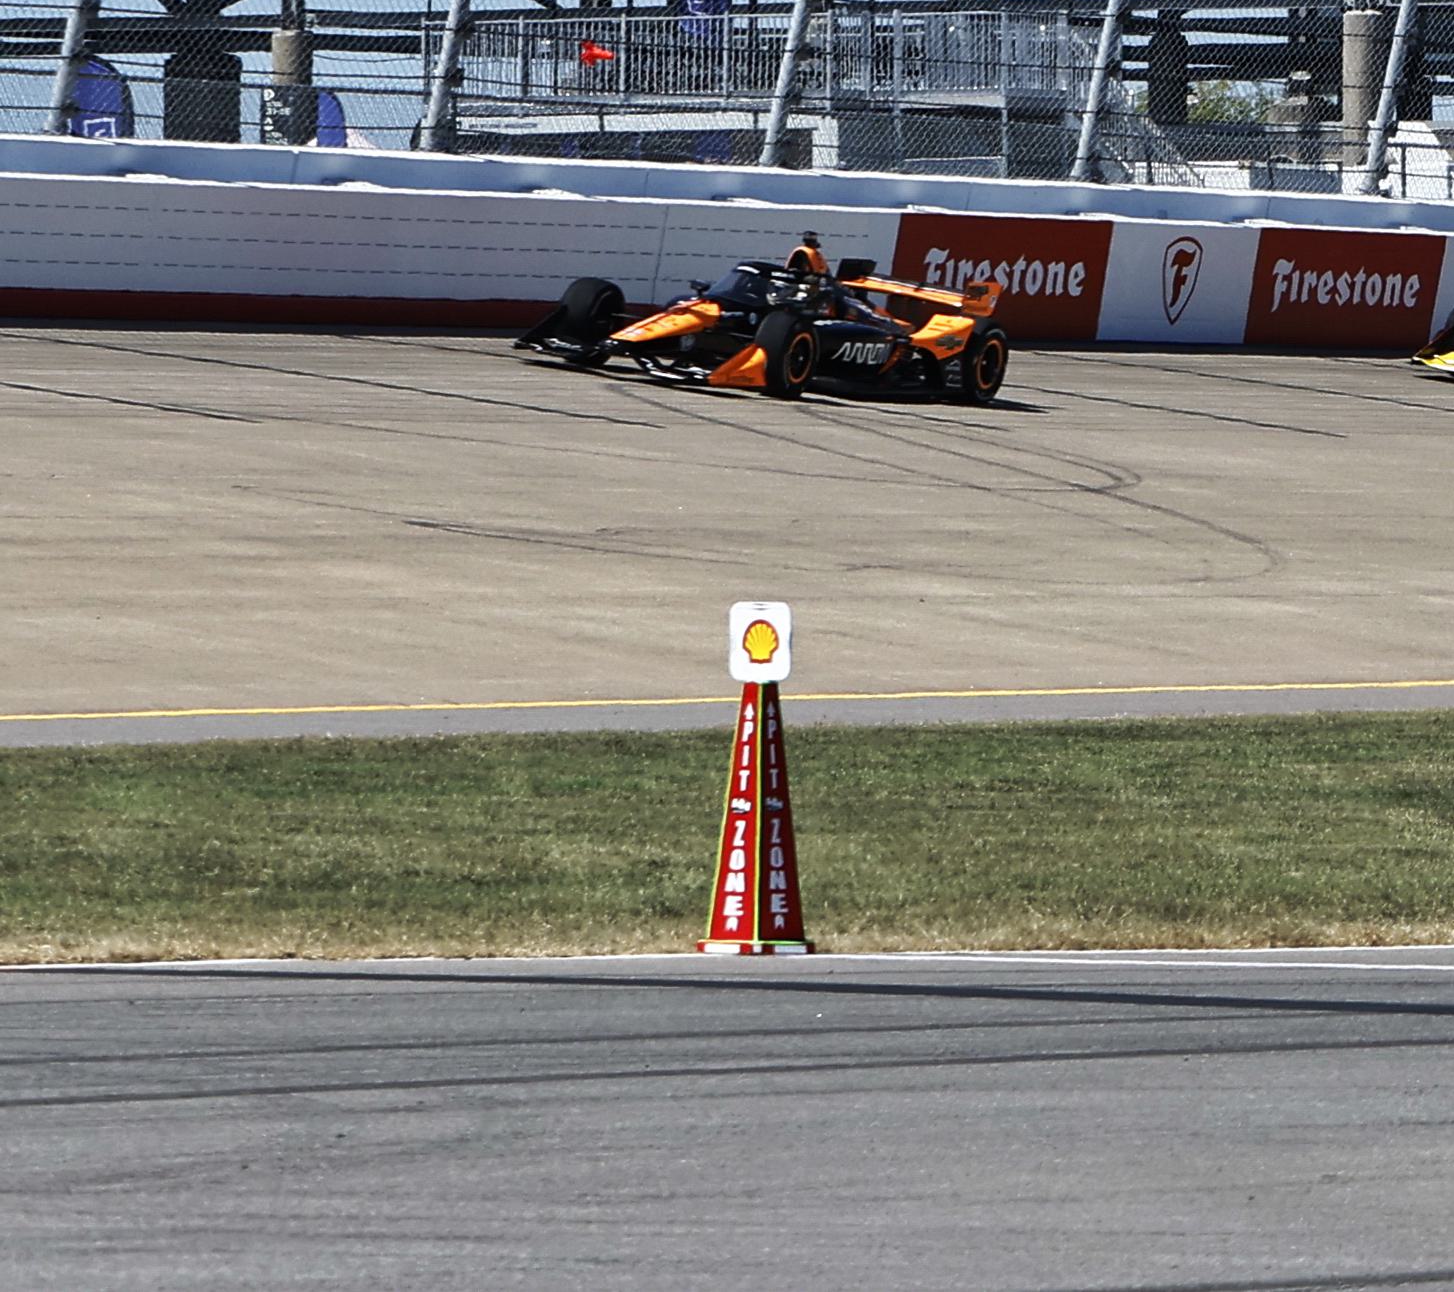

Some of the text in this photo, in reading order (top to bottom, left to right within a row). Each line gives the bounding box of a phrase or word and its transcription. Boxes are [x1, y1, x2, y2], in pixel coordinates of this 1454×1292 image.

[923, 246, 1085, 299] Firestone
[1271, 258, 1421, 313] Firestone
[723, 720, 755, 917] PIT ZONE
